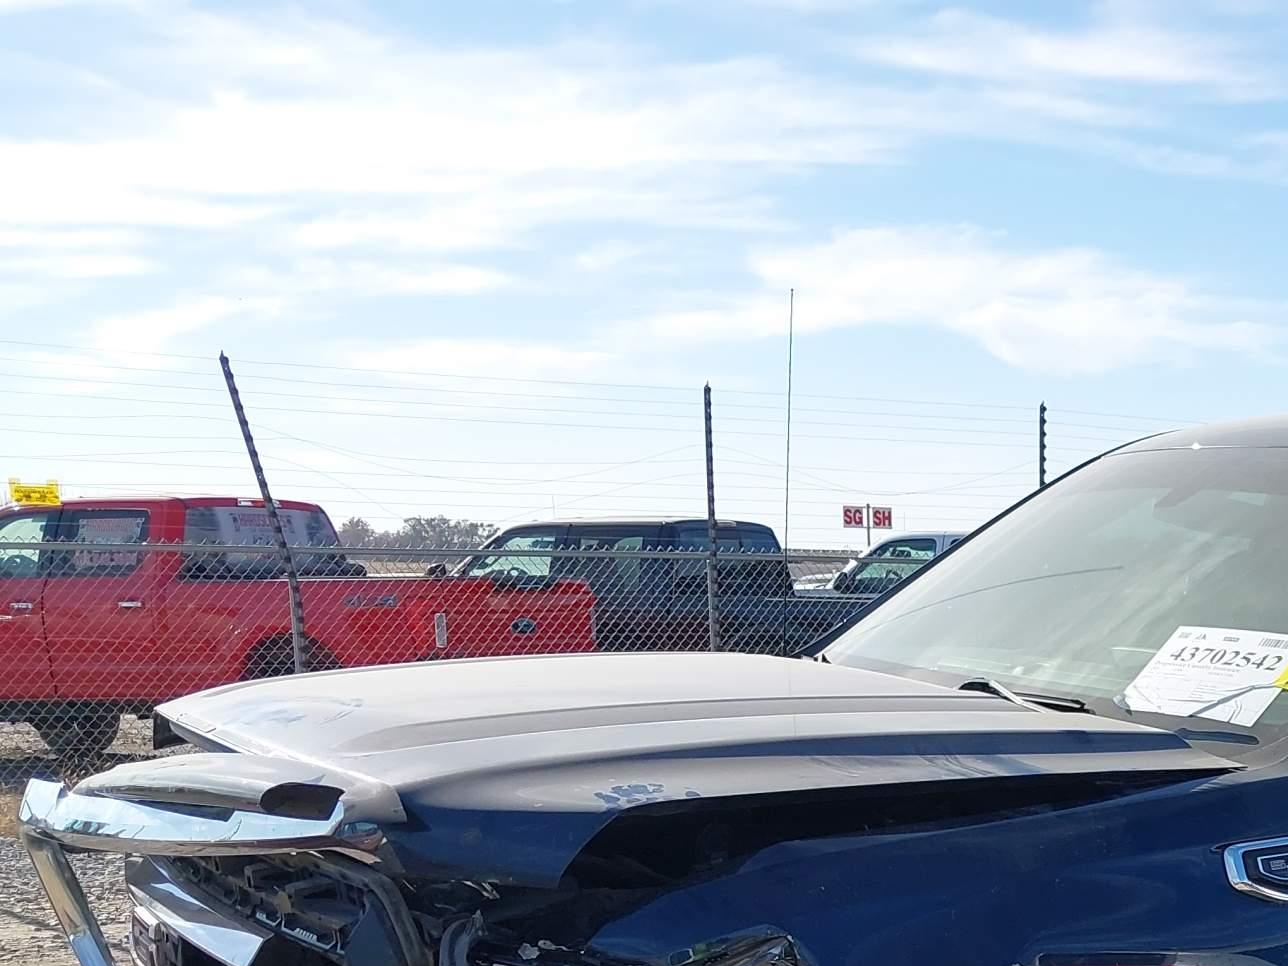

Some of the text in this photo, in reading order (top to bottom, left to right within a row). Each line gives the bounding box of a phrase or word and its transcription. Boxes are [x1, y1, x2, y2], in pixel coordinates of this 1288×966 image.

[844, 508, 863, 525] SG
[872, 510, 892, 527] SH
[1170, 646, 1283, 671] 43702542
